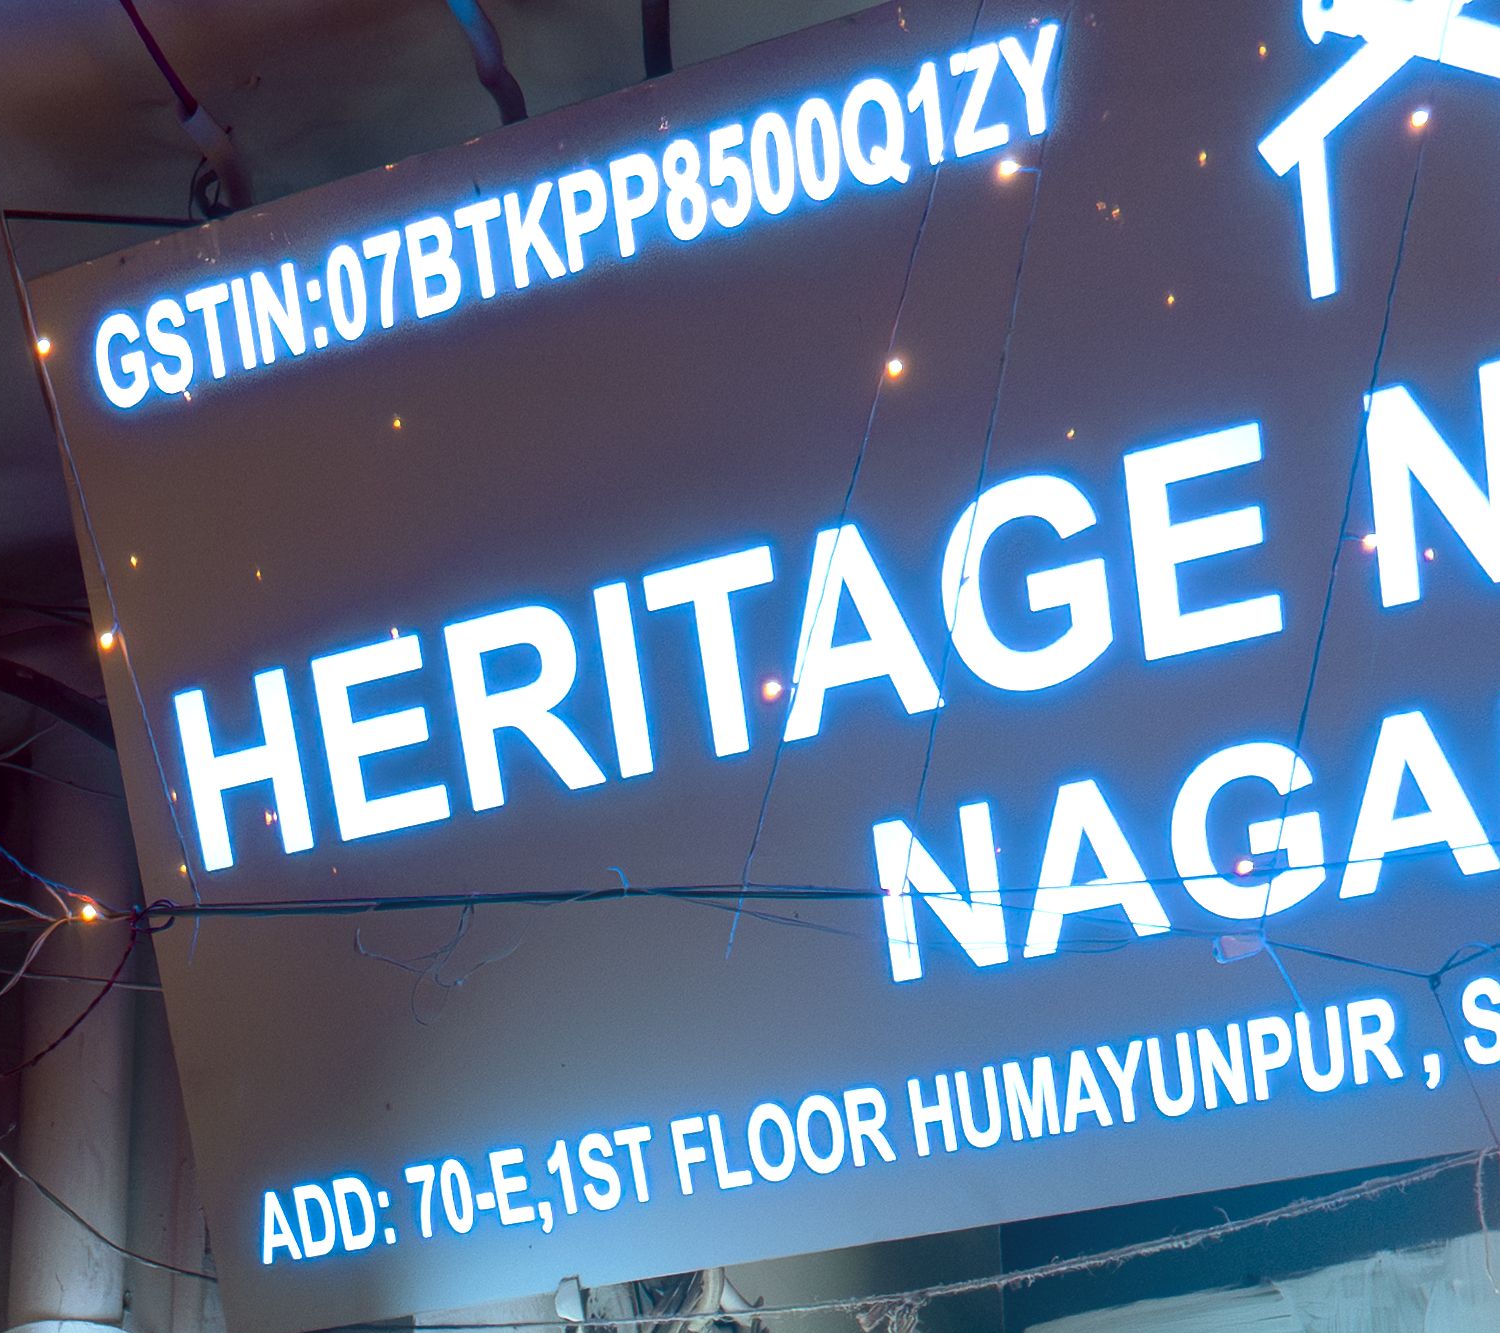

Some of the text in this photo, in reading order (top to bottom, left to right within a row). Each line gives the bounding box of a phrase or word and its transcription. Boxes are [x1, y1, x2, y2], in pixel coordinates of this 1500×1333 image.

[94, 21, 1062, 410] GSTIN:07BTKPP8500Q1ZY
[173, 420, 1284, 874] HERITAGE
[260, 1174, 396, 1267] ADD:
[671, 1086, 898, 1198] FLOOR
